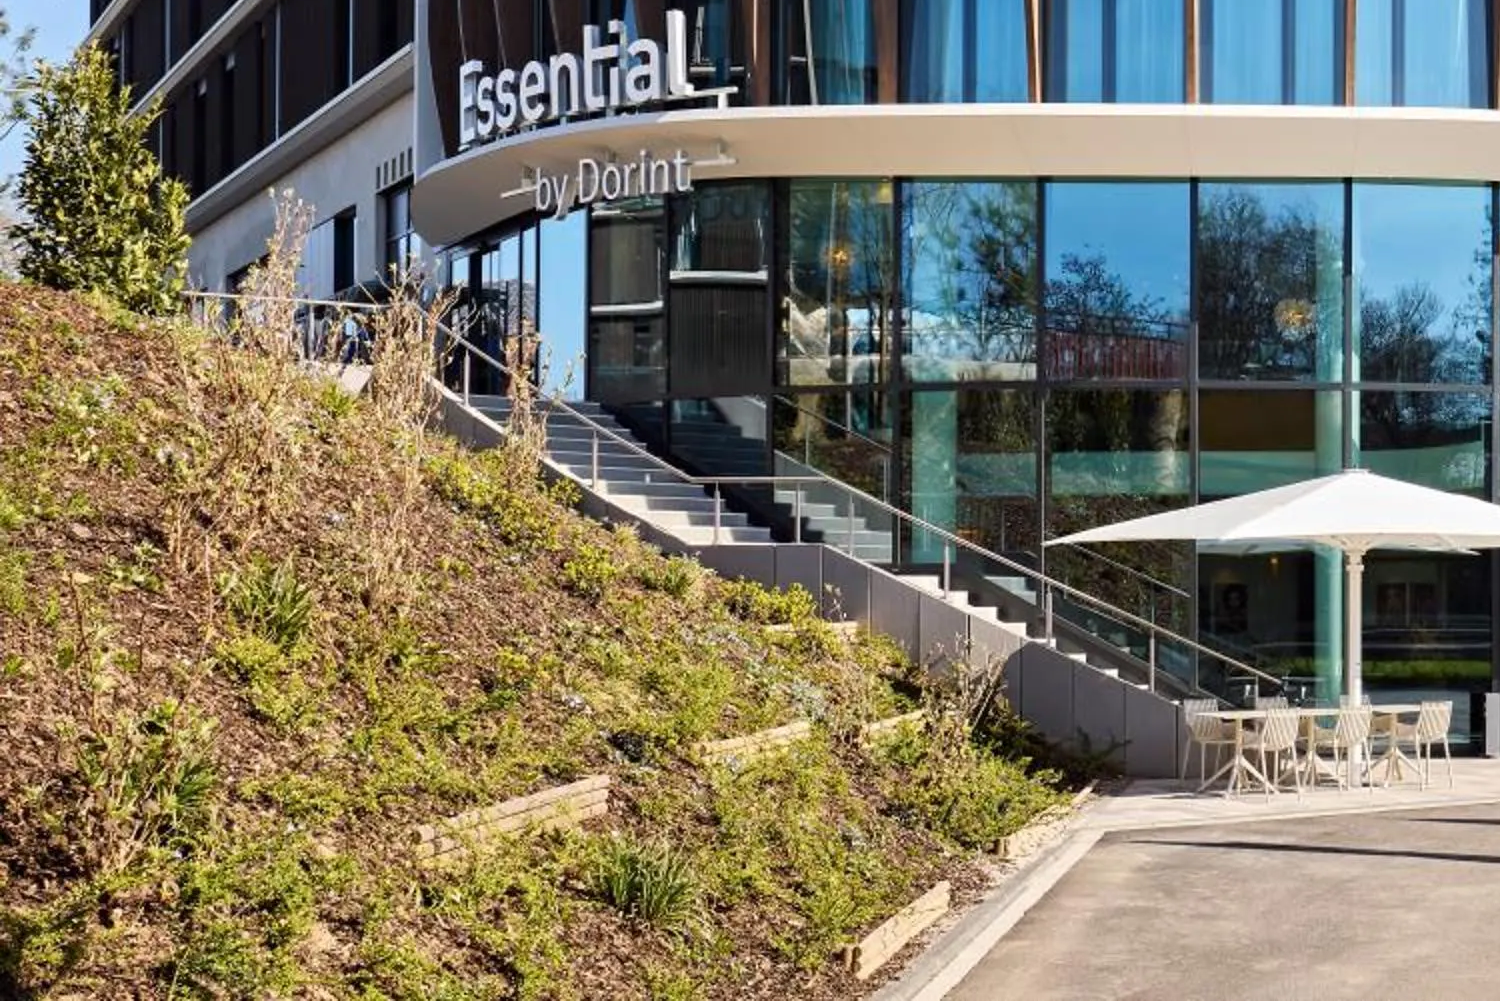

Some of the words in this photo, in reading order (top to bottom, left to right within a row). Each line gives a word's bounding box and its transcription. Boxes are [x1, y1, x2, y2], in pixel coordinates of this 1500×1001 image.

[458, 9, 695, 144] Essential
[535, 167, 570, 221] by
[579, 150, 692, 205] Dorint
